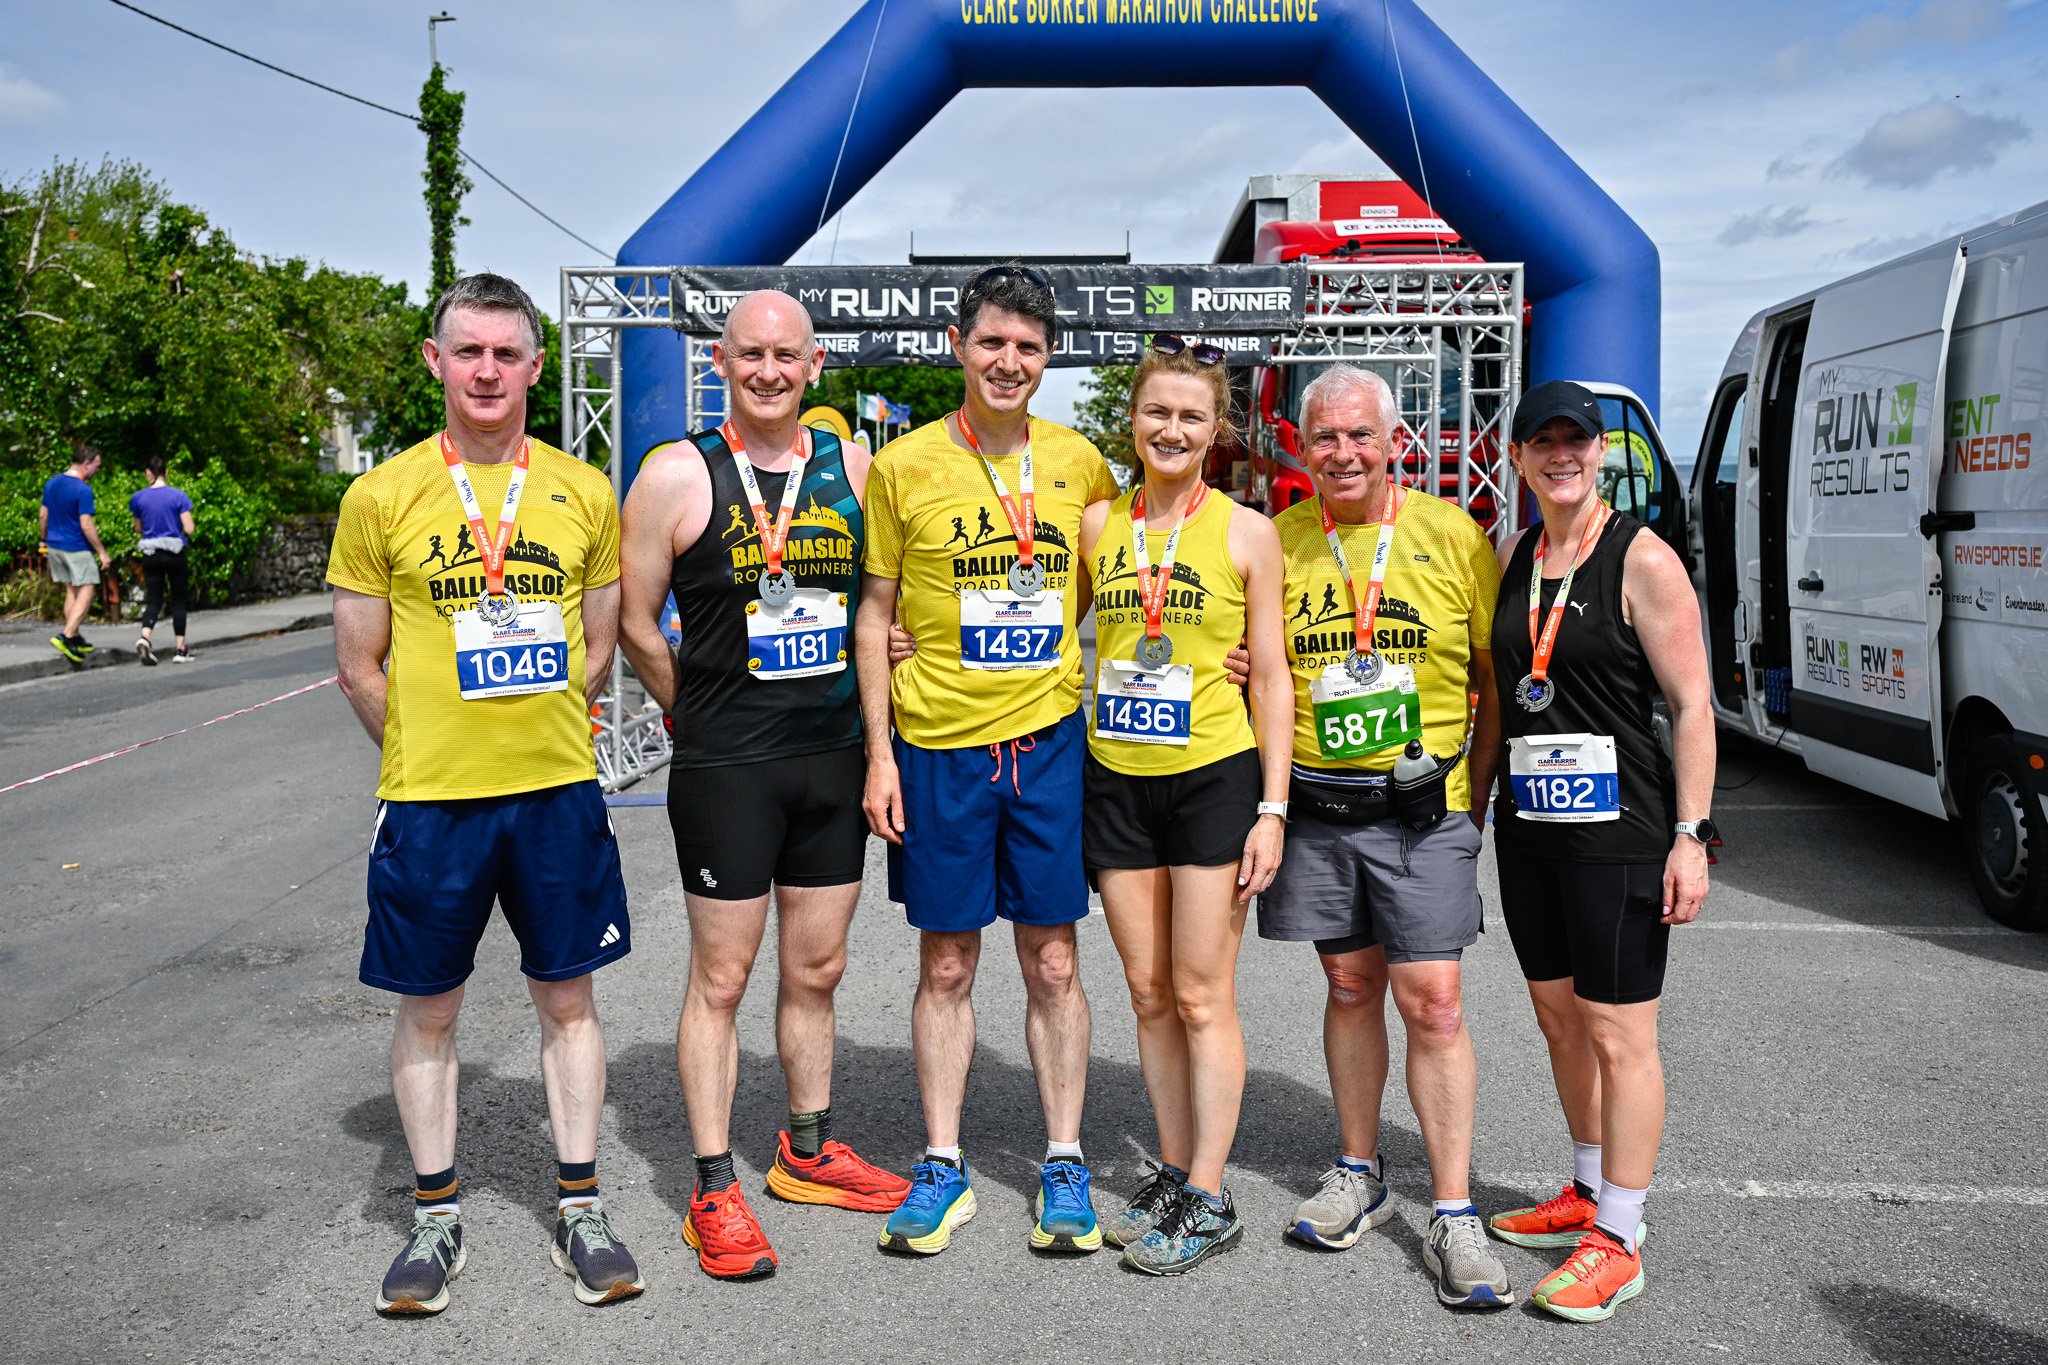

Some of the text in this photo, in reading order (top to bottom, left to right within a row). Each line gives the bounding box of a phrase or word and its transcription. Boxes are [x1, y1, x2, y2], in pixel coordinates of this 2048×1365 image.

[800, 289, 827, 302] MY
[831, 288, 920, 317] RUN
[1191, 287, 1292, 312] RUNNER
[815, 338, 860, 353] NNER
[872, 331, 895, 343] MY
[1052, 331, 1136, 355] ULTS
[1819, 367, 1840, 396] MY
[1813, 388, 1882, 455] RUN
[1950, 394, 2001, 438] ENT
[1954, 432, 2031, 474] NEEDS
[1810, 451, 1910, 498] RESULTS
[731, 538, 853, 568] BAINASLOE
[953, 553, 1069, 577] BALLINSLOE
[1955, 545, 2042, 568] RWSPORTS.IE
[788, 562, 853, 577] RUNNERS
[429, 574, 565, 601] BALLIASLOE
[954, 579, 1001, 592] ROAD
[1094, 589, 1206, 613] BALLINSLOE
[1131, 612, 1202, 626] RUNERS
[773, 632, 827, 667] 1181
[974, 629, 1050, 659] 1437
[1806, 635, 1835, 665] RUN
[469, 646, 558, 684] 1046
[1861, 644, 1887, 674] RW
[1350, 682, 1385, 694] RESULTS
[1808, 662, 1850, 688] RESULTS
[1862, 674, 1906, 700] SPORTS
[1105, 698, 1176, 732] 1436
[1324, 703, 1409, 749] 5871
[1525, 777, 1596, 809] 1182
